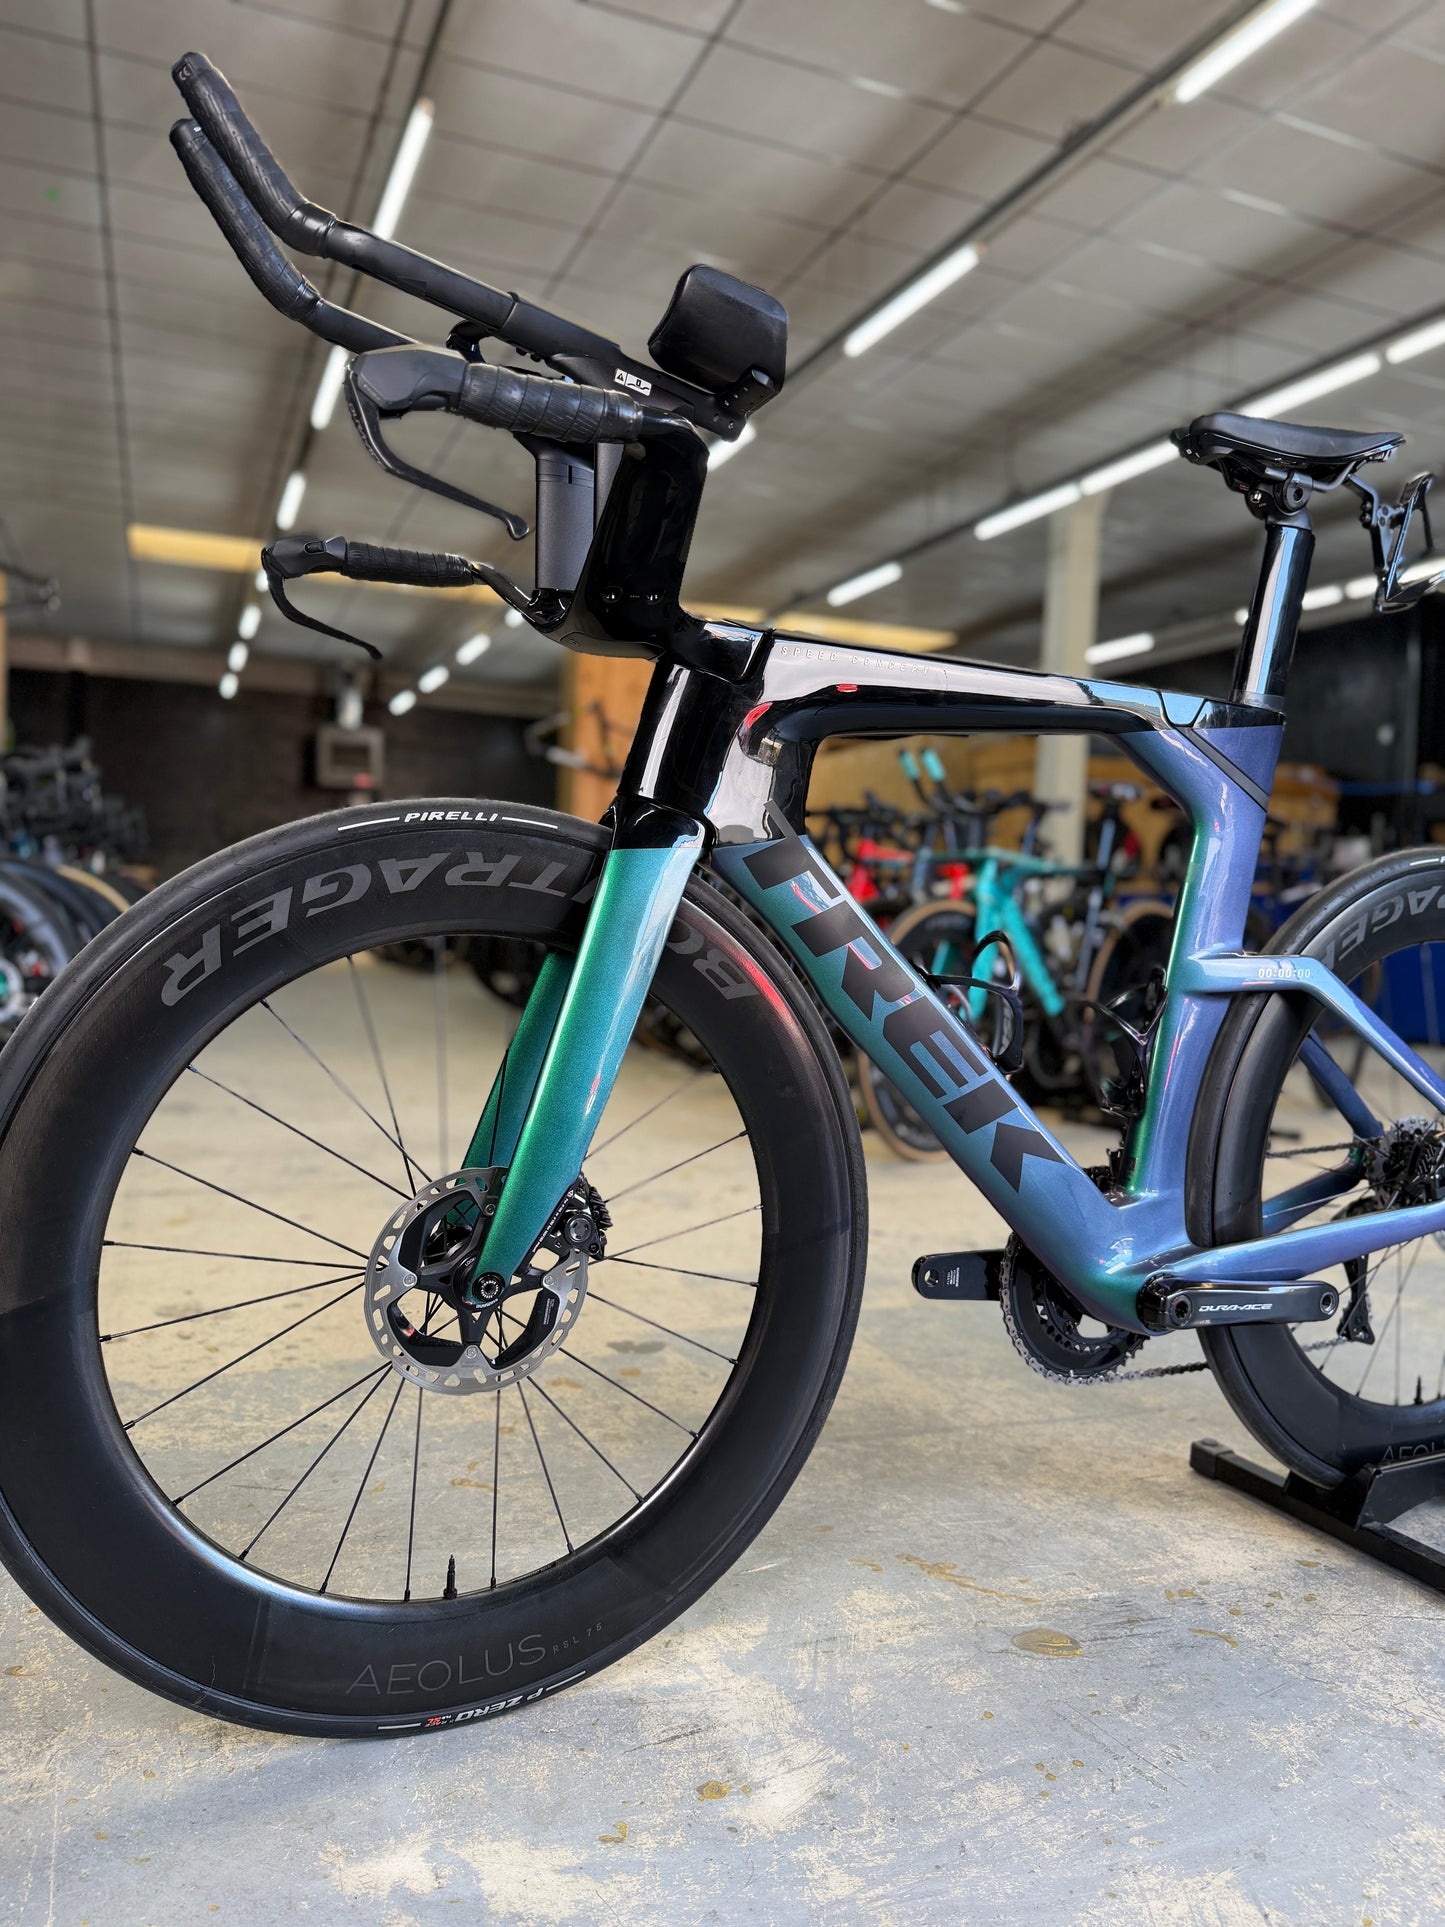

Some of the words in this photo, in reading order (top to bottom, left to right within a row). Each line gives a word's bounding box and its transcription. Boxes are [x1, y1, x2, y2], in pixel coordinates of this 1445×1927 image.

[780, 646, 838, 661] SPEED
[851, 655, 929, 675] CONCEPT
[404, 811, 498, 822] PIRELLI
[1257, 967, 1311, 979] 00:00:00
[742, 799, 1066, 1194] TREK
[1198, 1303, 1273, 1313] DURA-ACE
[345, 1633, 546, 1696] AEOLUS
[552, 1635, 580, 1656] RSL
[526, 1687, 544, 1701] P
[454, 1695, 524, 1722] ZERO
